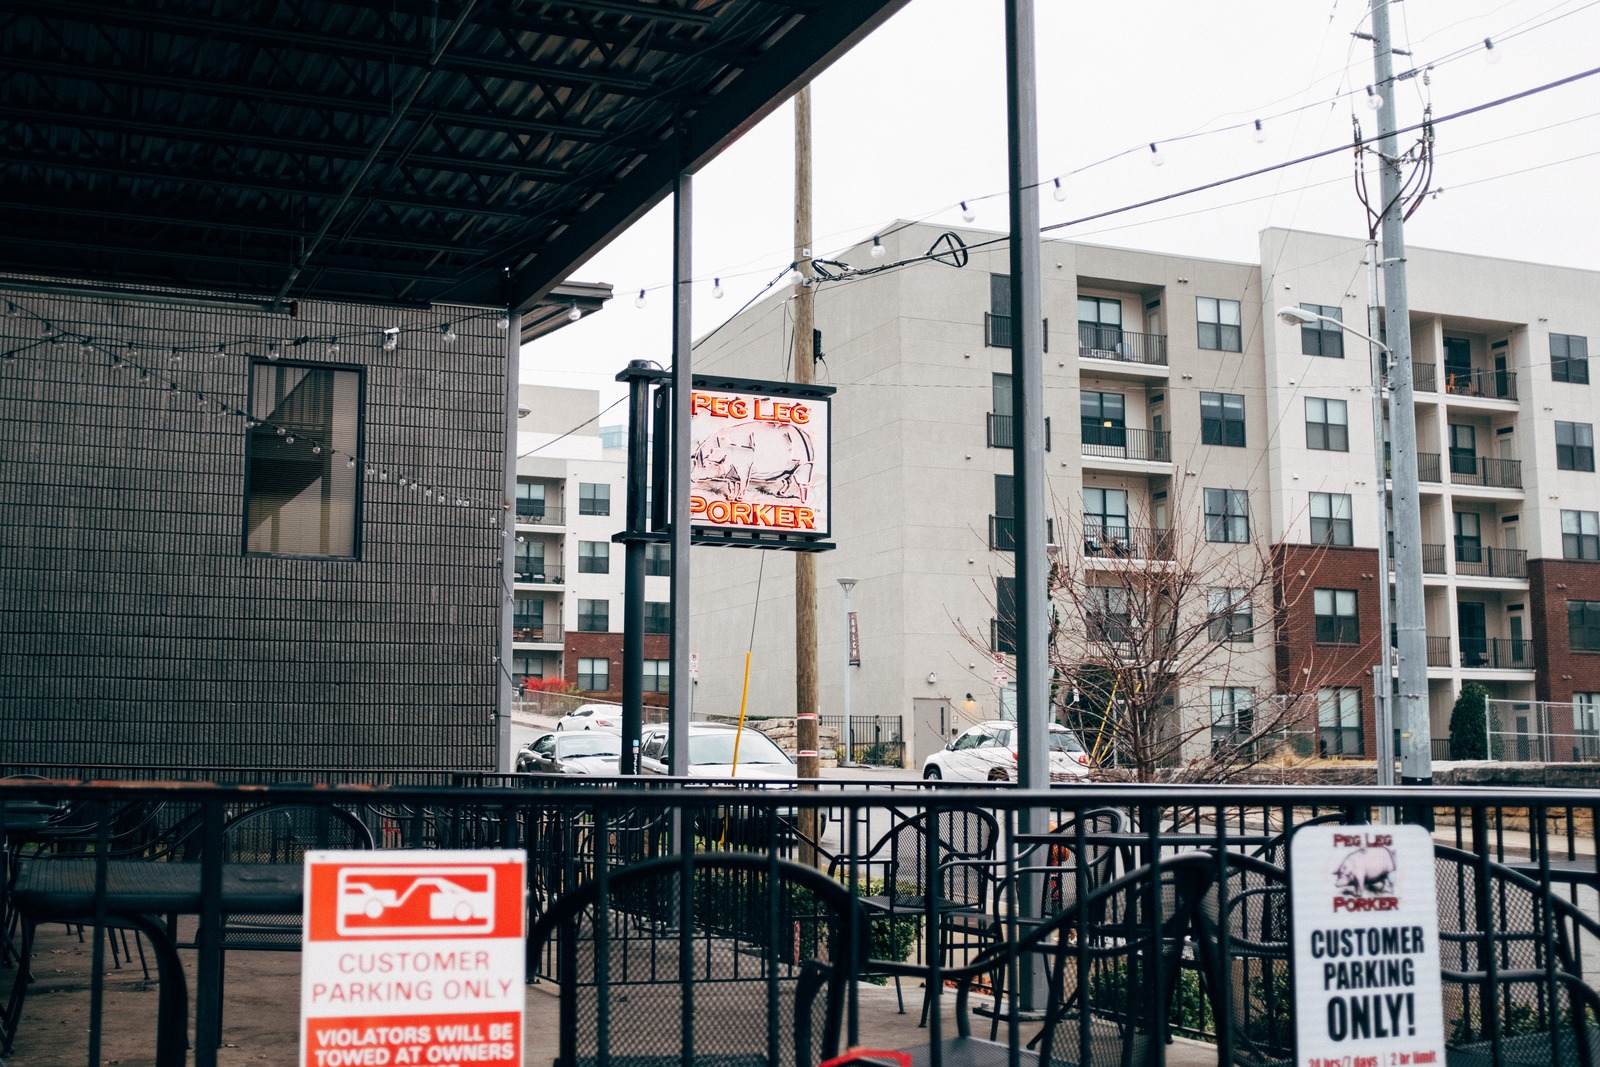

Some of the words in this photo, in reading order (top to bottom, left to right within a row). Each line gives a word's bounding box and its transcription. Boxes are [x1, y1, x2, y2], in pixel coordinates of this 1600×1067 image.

[691, 393, 748, 419] PEG
[754, 397, 809, 424] LEG
[690, 496, 815, 529] PORKER
[1333, 834, 1361, 847] PEG
[1366, 833, 1393, 847] LEG
[1333, 897, 1399, 912] PORKER
[1311, 926, 1424, 959] CUSTOMER
[338, 952, 489, 973] CUSTOMER
[1324, 957, 1415, 991] PARKING
[312, 980, 432, 1003] PARKING
[443, 979, 513, 1000] ONLY
[1327, 992, 1416, 1042] ONLY!
[316, 1025, 431, 1047] VIOLATORS
[435, 1024, 484, 1043] WILL
[489, 1023, 513, 1040] BE
[314, 1049, 390, 1067] TOWED
[395, 1047, 422, 1064] AT
[427, 1043, 515, 1061] OWNERS
[1354, 1055, 1378, 1067] days
[1391, 1054, 1398, 1066] 2
[1401, 1054, 1410, 1065] hr
[1413, 1051, 1436, 1064] limit
